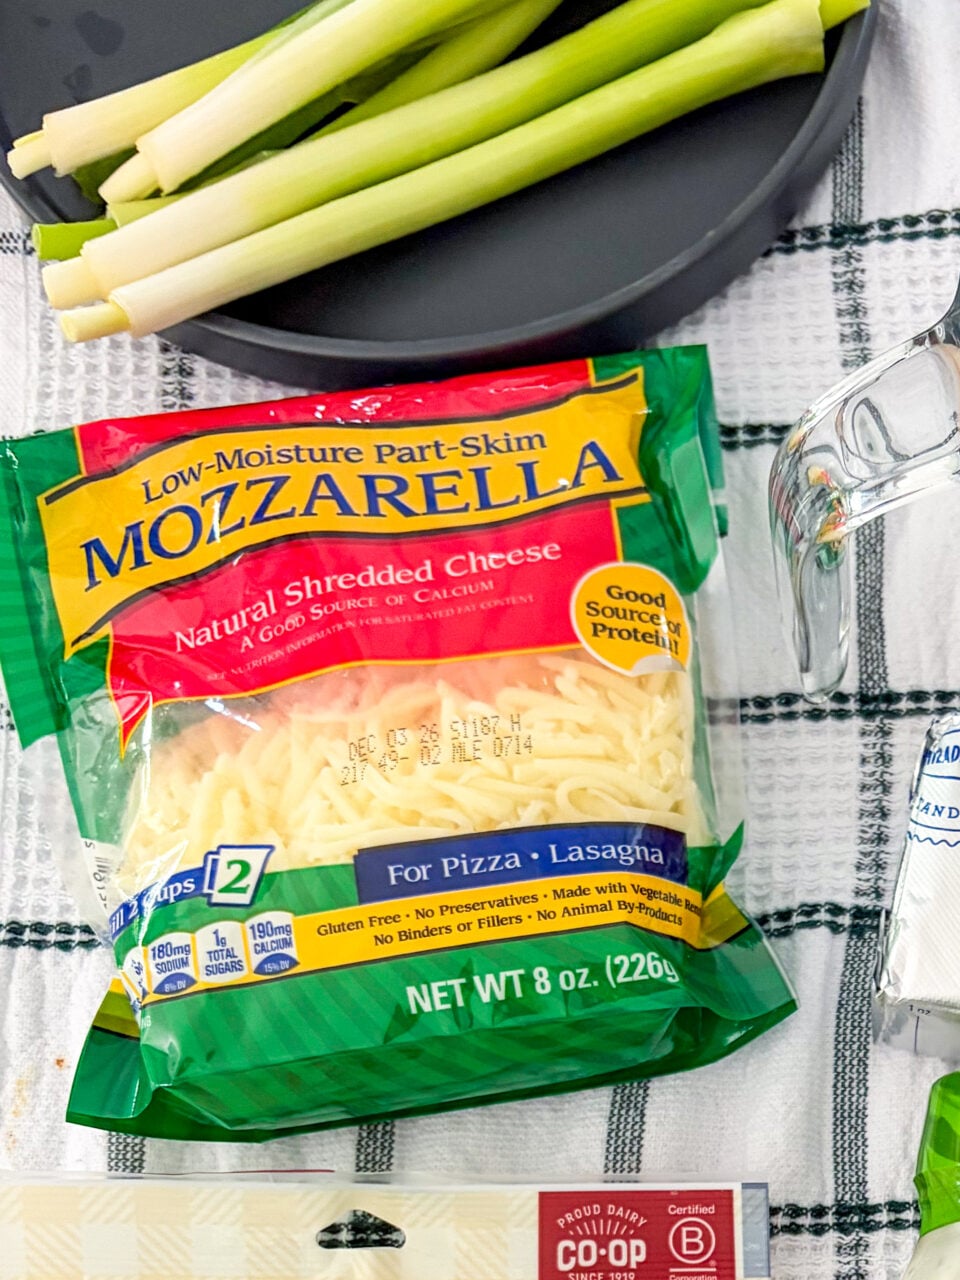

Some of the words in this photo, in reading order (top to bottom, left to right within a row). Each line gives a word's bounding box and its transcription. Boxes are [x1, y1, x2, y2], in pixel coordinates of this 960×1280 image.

[141, 444, 363, 504] Low-Moisture
[374, 432, 547, 464] Part-Skim
[79, 440, 624, 592] MOZZARELLA
[174, 589, 278, 653] Natural
[283, 559, 434, 607] Shredded
[444, 541, 562, 578] Cheese
[606, 584, 667, 610] Good
[585, 601, 662, 627] Source
[590, 622, 680, 656] Protein!
[387, 863, 432, 886] For
[441, 852, 522, 878] Pizza
[548, 843, 665, 867] Lasagna
[317, 919, 364, 937] Gluten
[368, 912, 402, 928] Free
[414, 907, 436, 920] No
[439, 893, 540, 916] Preservatives
[552, 884, 592, 900] Made
[595, 881, 628, 895] with
[630, 883, 683, 908] Vegetable
[374, 933, 394, 946] No
[398, 924, 453, 942] Binders
[456, 919, 473, 932] or
[477, 913, 524, 930] Fillers
[537, 909, 557, 922] No
[561, 900, 613, 919] Animal
[618, 899, 683, 926] By-Products
[249, 920, 292, 941] 190mg
[151, 941, 191, 962] 180mg
[253, 937, 293, 955] CALCIUM
[155, 957, 191, 975] SODIUM
[406, 977, 467, 1014] NET
[473, 969, 526, 1004] WT
[533, 966, 550, 995] 8
[559, 967, 599, 992] oz.
[557, 1204, 601, 1229] PROUD
[607, 1203, 648, 1228] DAIRY
[668, 1204, 715, 1216] Certified
